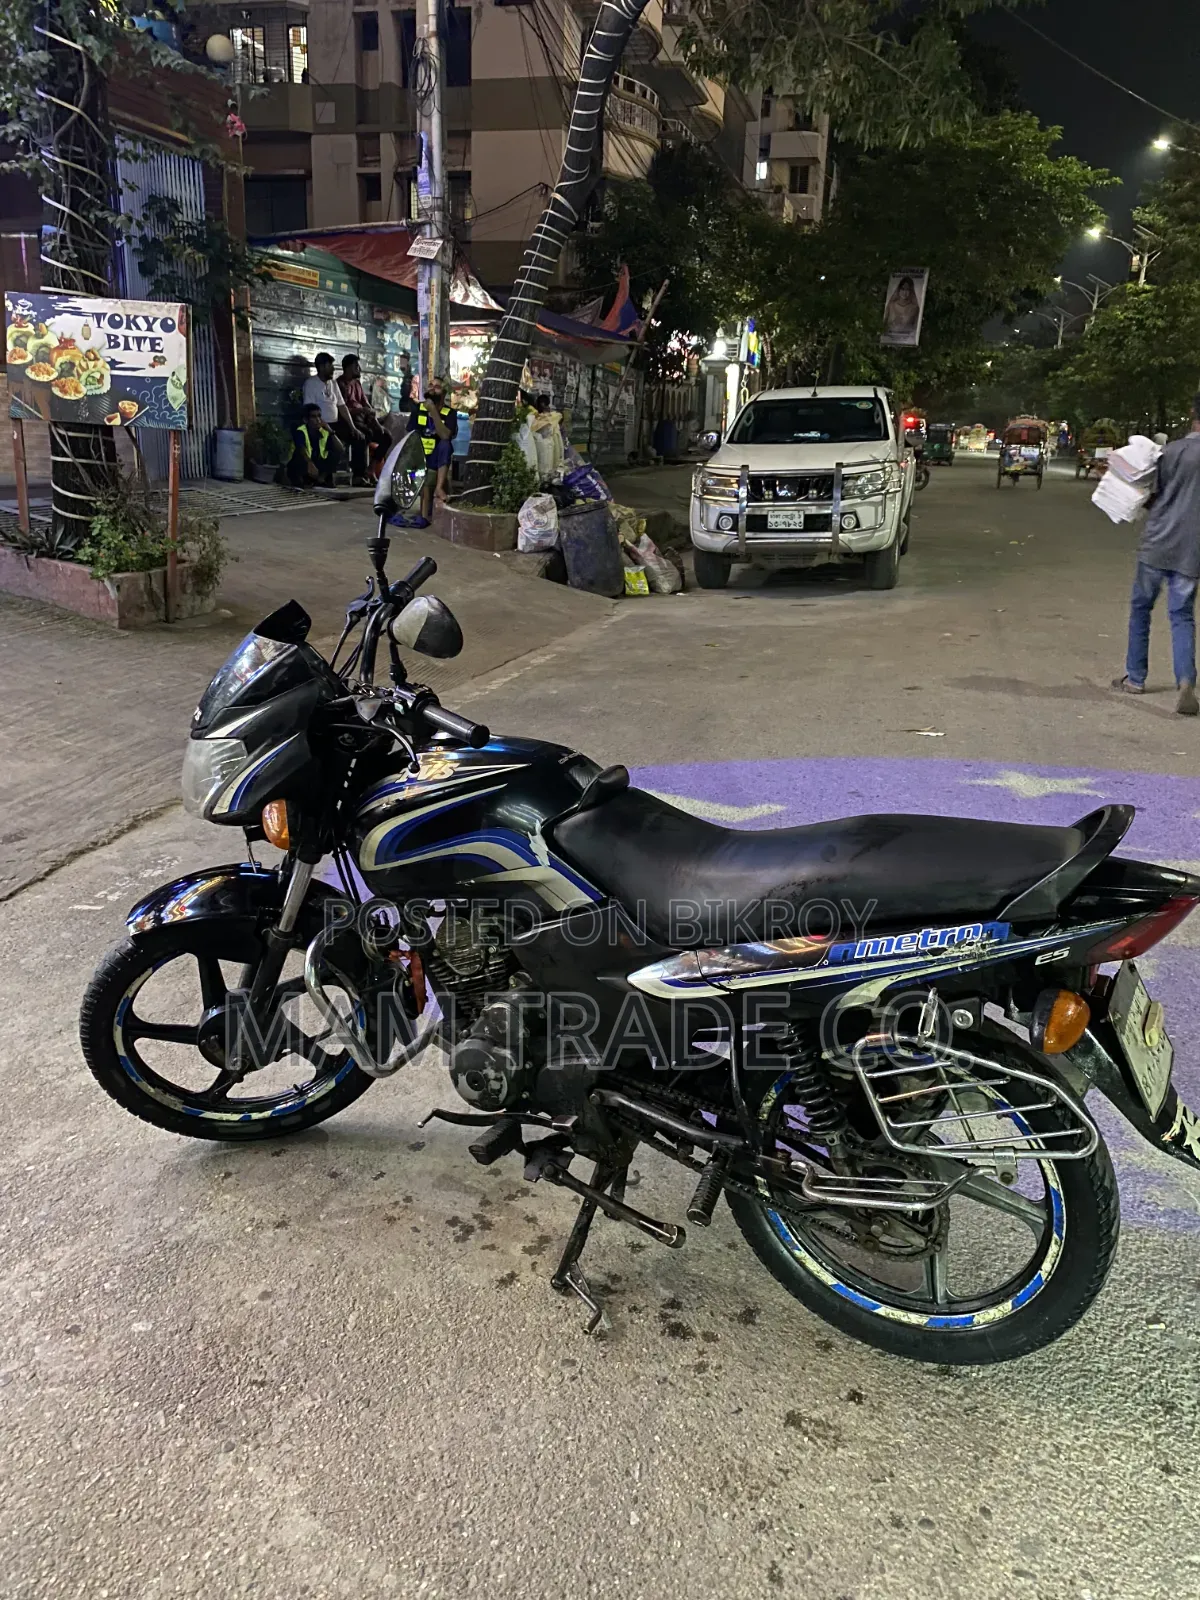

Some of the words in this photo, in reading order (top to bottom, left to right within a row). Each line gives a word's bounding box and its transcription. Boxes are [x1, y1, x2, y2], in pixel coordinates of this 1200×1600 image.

[91, 312, 176, 333] TOKYO
[106, 333, 164, 353] BITE
[853, 922, 984, 959] metro
[1035, 946, 1071, 966] ES
